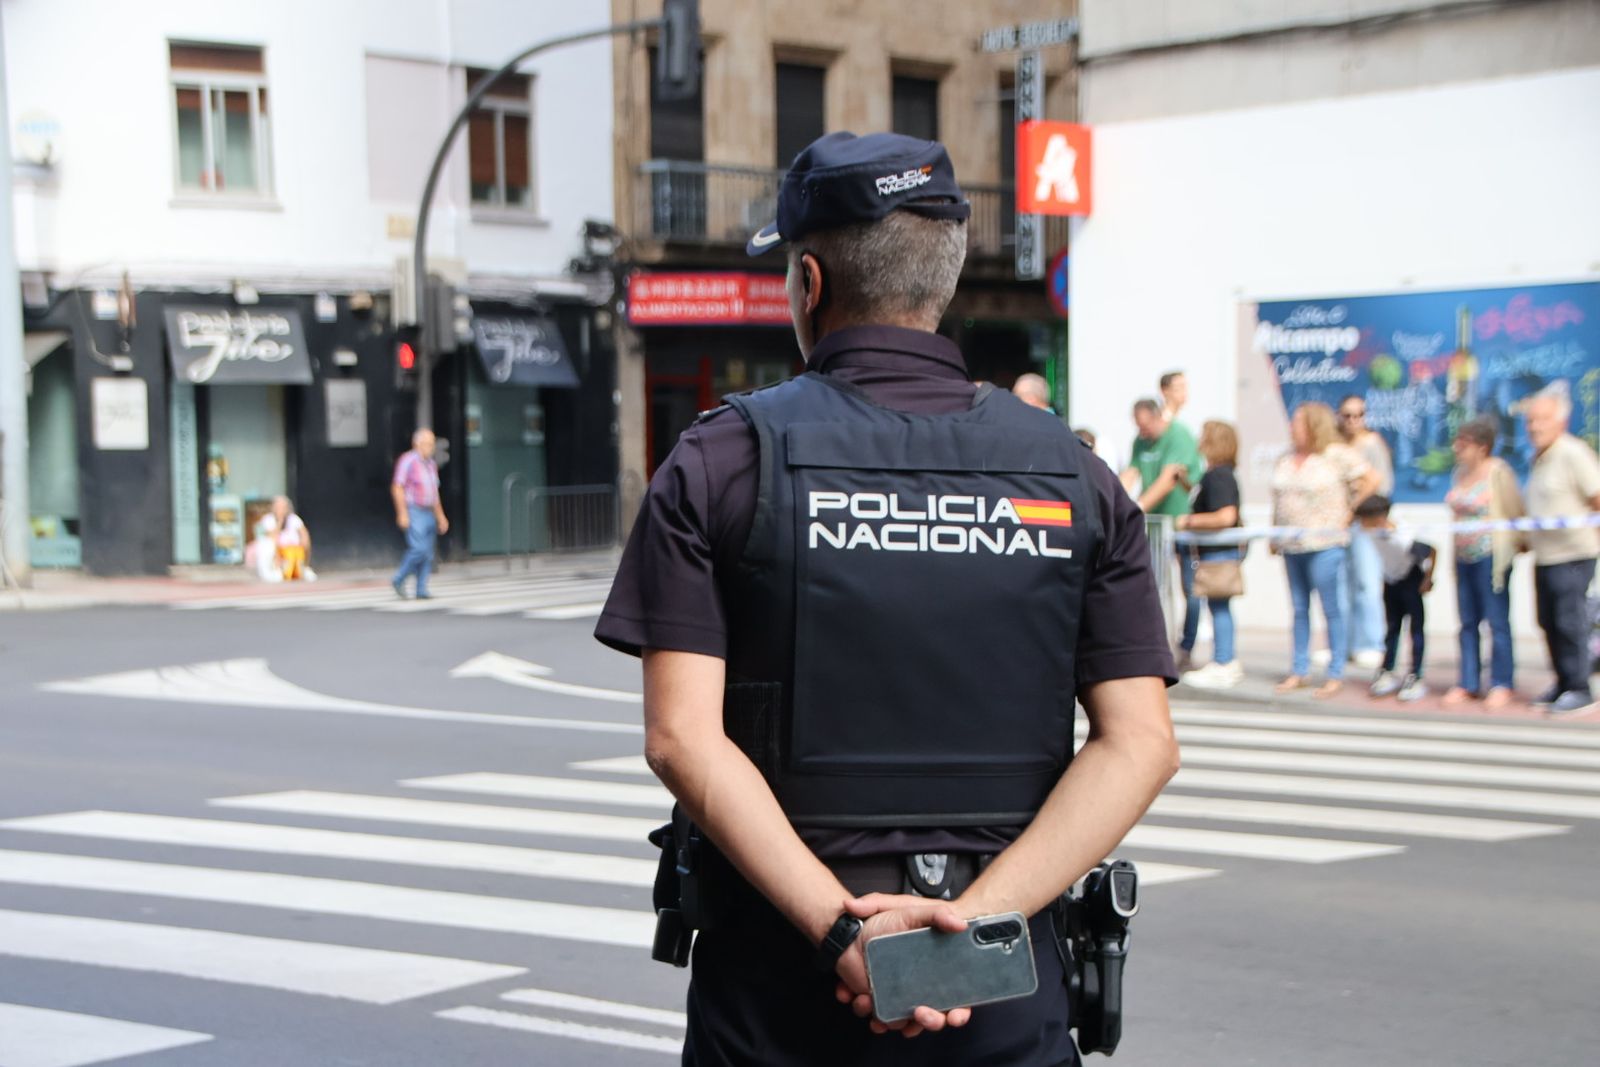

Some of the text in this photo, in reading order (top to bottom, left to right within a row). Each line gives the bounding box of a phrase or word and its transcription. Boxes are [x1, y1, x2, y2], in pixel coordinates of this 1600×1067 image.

[876, 168, 926, 188] POLICIA
[879, 176, 932, 196] NACIONAL
[1252, 321, 1360, 356] Alcampo
[809, 491, 1022, 525] POLICIA
[809, 522, 1072, 559] NACIONAL
